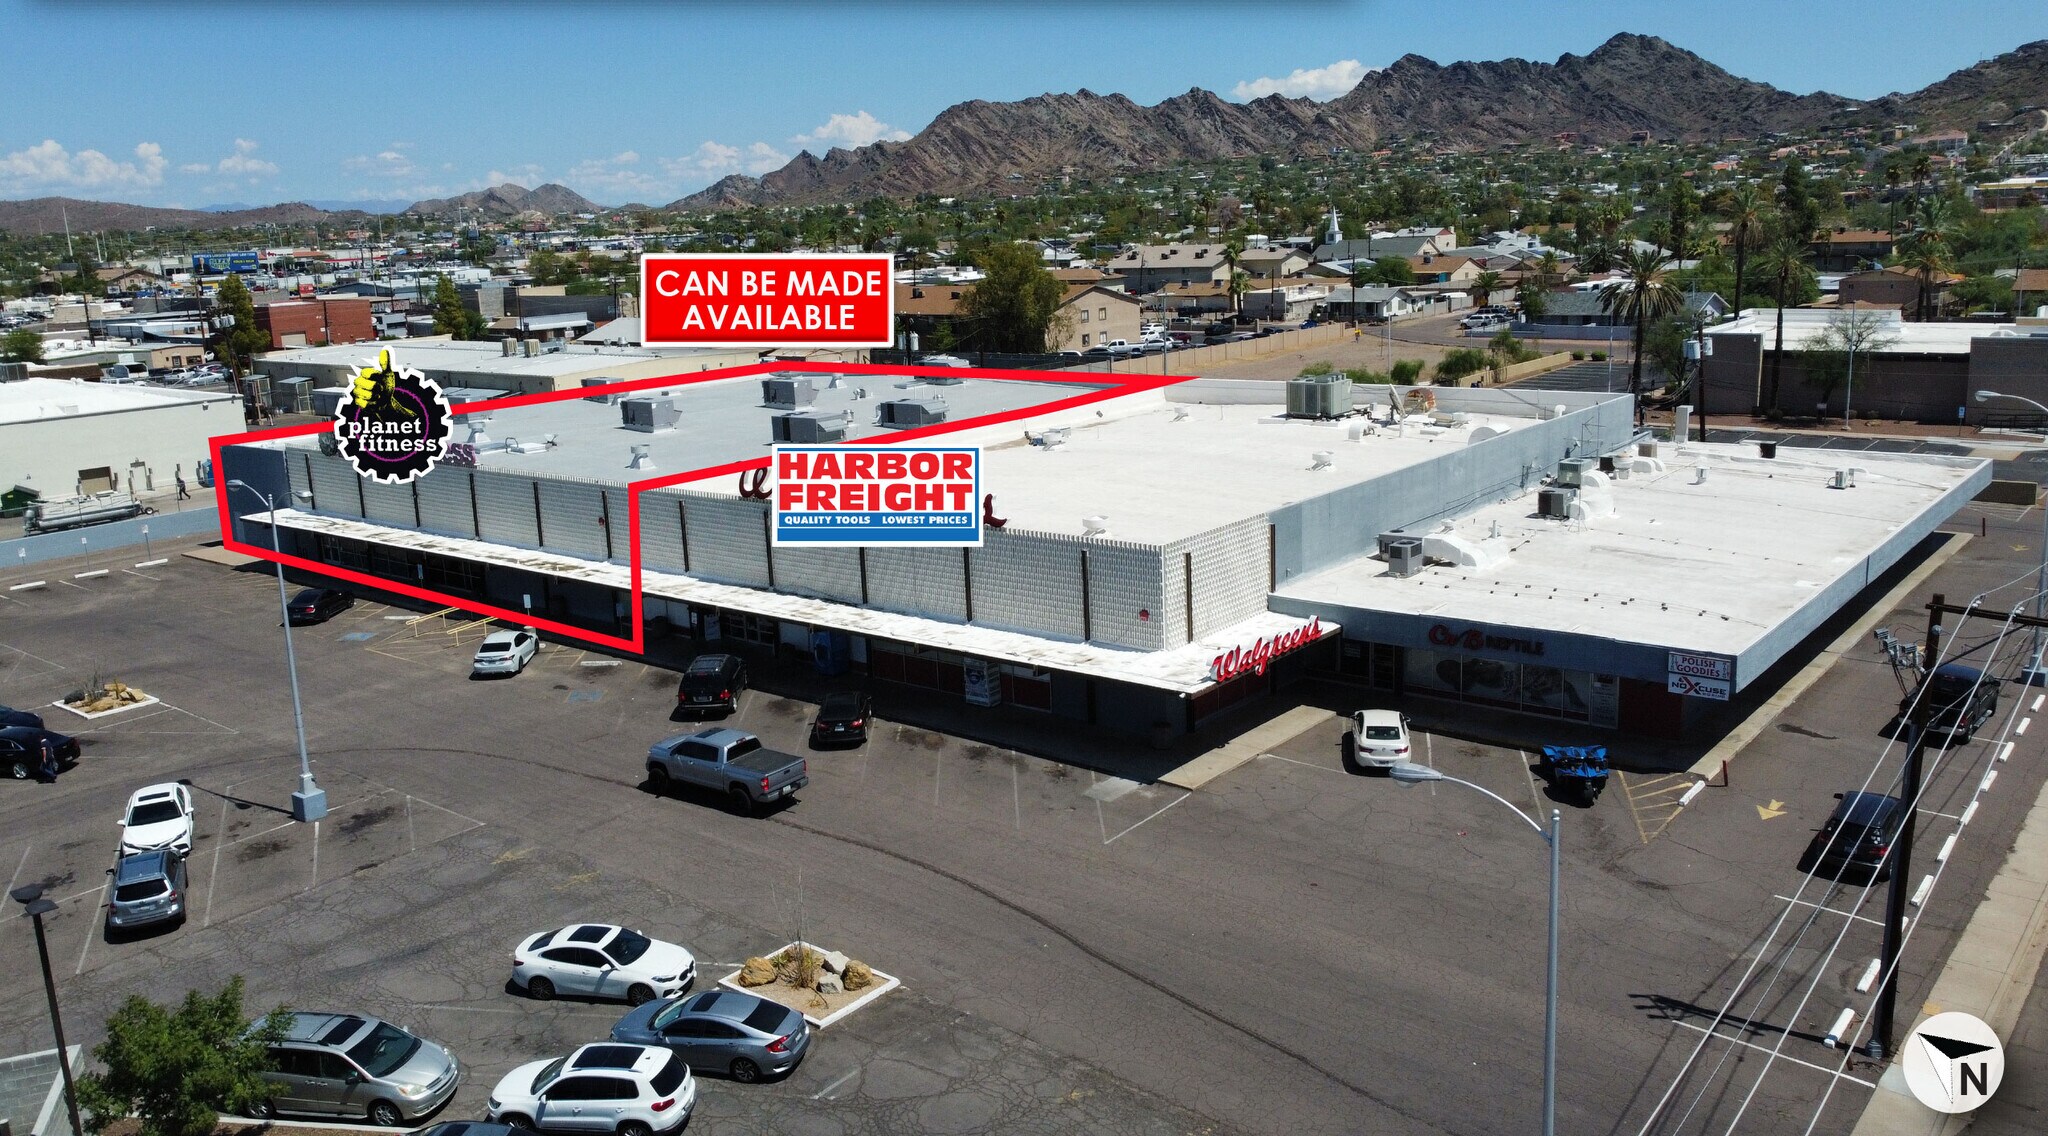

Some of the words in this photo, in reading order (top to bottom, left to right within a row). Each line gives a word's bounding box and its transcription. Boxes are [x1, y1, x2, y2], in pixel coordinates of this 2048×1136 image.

[1211, 615, 1324, 682] Walgreens
[1681, 657, 1716, 669] POLISH
[1676, 664, 1720, 678] GOODIES
